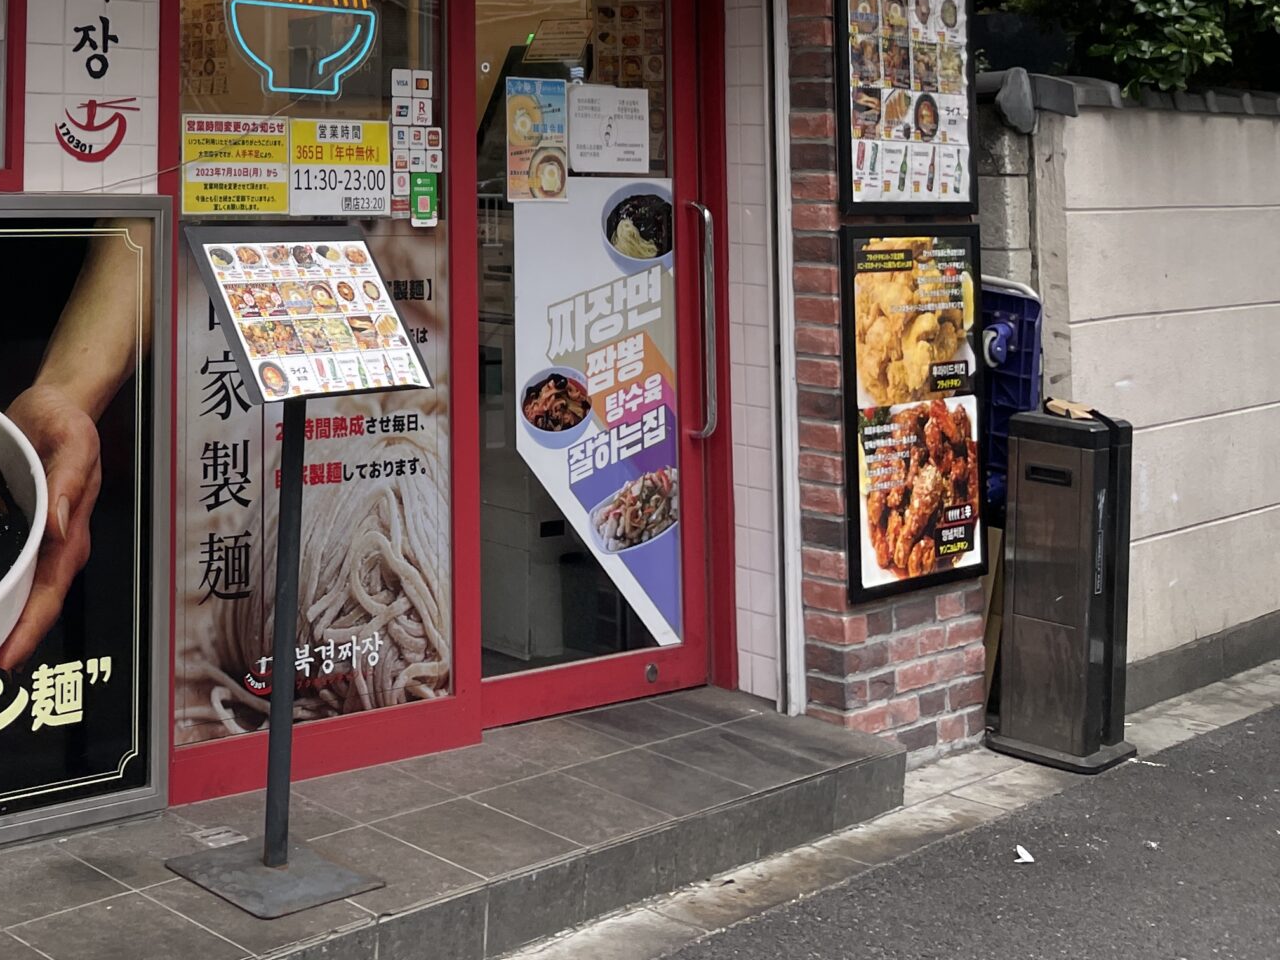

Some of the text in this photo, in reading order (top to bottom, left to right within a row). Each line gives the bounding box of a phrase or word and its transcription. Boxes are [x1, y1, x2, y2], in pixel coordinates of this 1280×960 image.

[58, 122, 93, 154] 170301
[187, 120, 284, 133] 営業時間変更のお知らせ
[318, 124, 361, 140] 営業時間
[294, 168, 386, 191] 11:30-23:00
[341, 196, 386, 211] (閉店23:20)
[547, 265, 662, 361] 짜장면
[586, 332, 645, 396] 짬뽕
[605, 373, 663, 424] 탕수육
[275, 414, 425, 441] 2時間熟成させ毎日、
[198, 296, 252, 607] 家製麺
[294, 631, 384, 677] 북경짜장
